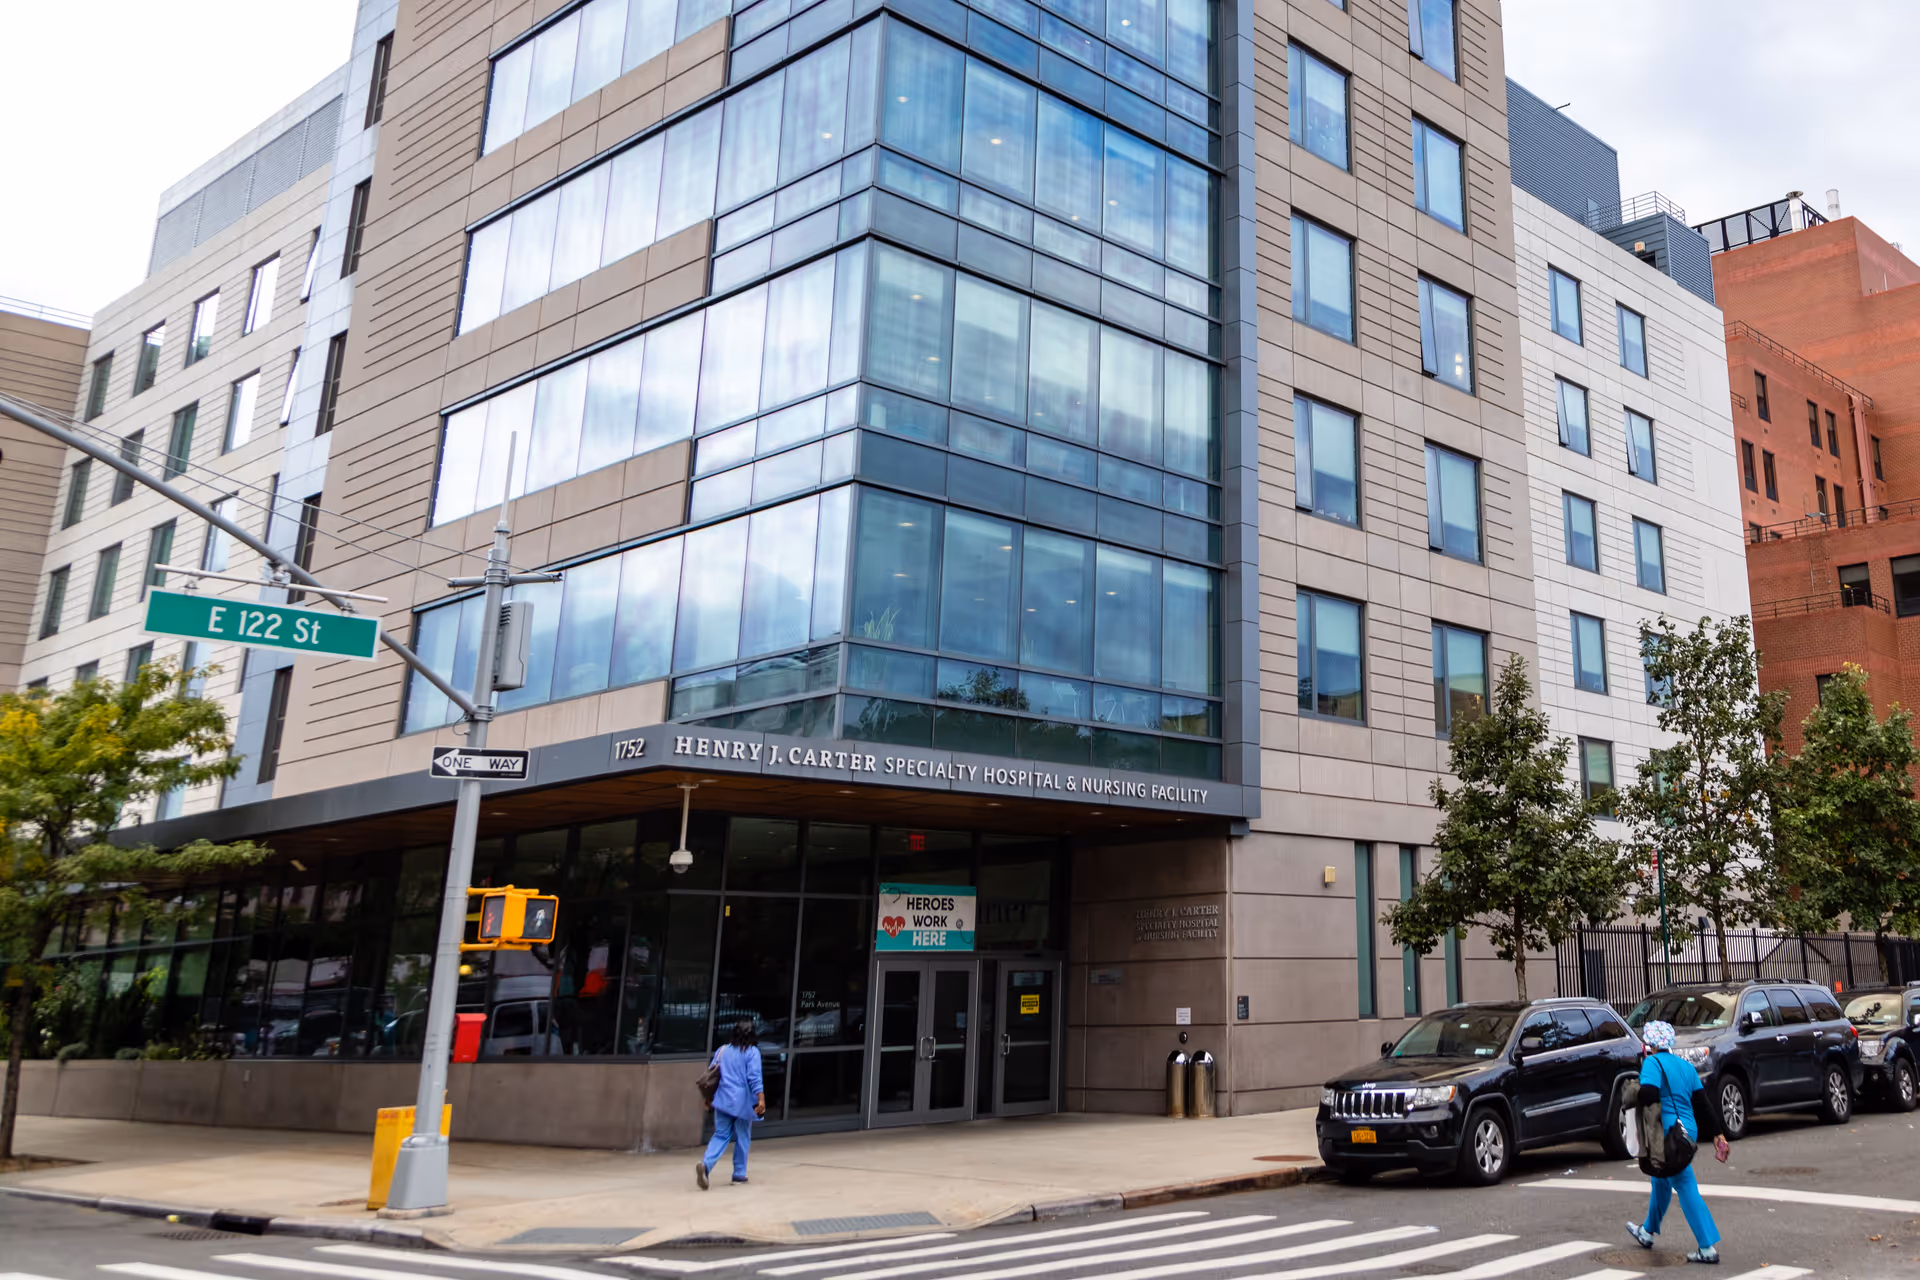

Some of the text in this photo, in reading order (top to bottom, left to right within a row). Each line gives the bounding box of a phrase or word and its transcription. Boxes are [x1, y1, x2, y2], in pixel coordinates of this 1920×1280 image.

[208, 606, 321, 644] E 122 St
[614, 738, 645, 760] 1752
[442, 756, 520, 770] ONE WAY
[674, 736, 1208, 804] HENRY J. CARTER SPECIALTY HOSPITAL & NURSING FACILITY
[906, 897, 955, 911] HEROES
[1180, 905, 1219, 916] CARTER
[912, 915, 948, 928] WORK
[1136, 919, 1219, 930] SPECIALTY HOSPITAL
[912, 930, 947, 946] HERE
[1144, 931, 1180, 941] NURSING
[1182, 928, 1218, 938] FACILITY
[802, 991, 816, 999] 1752
